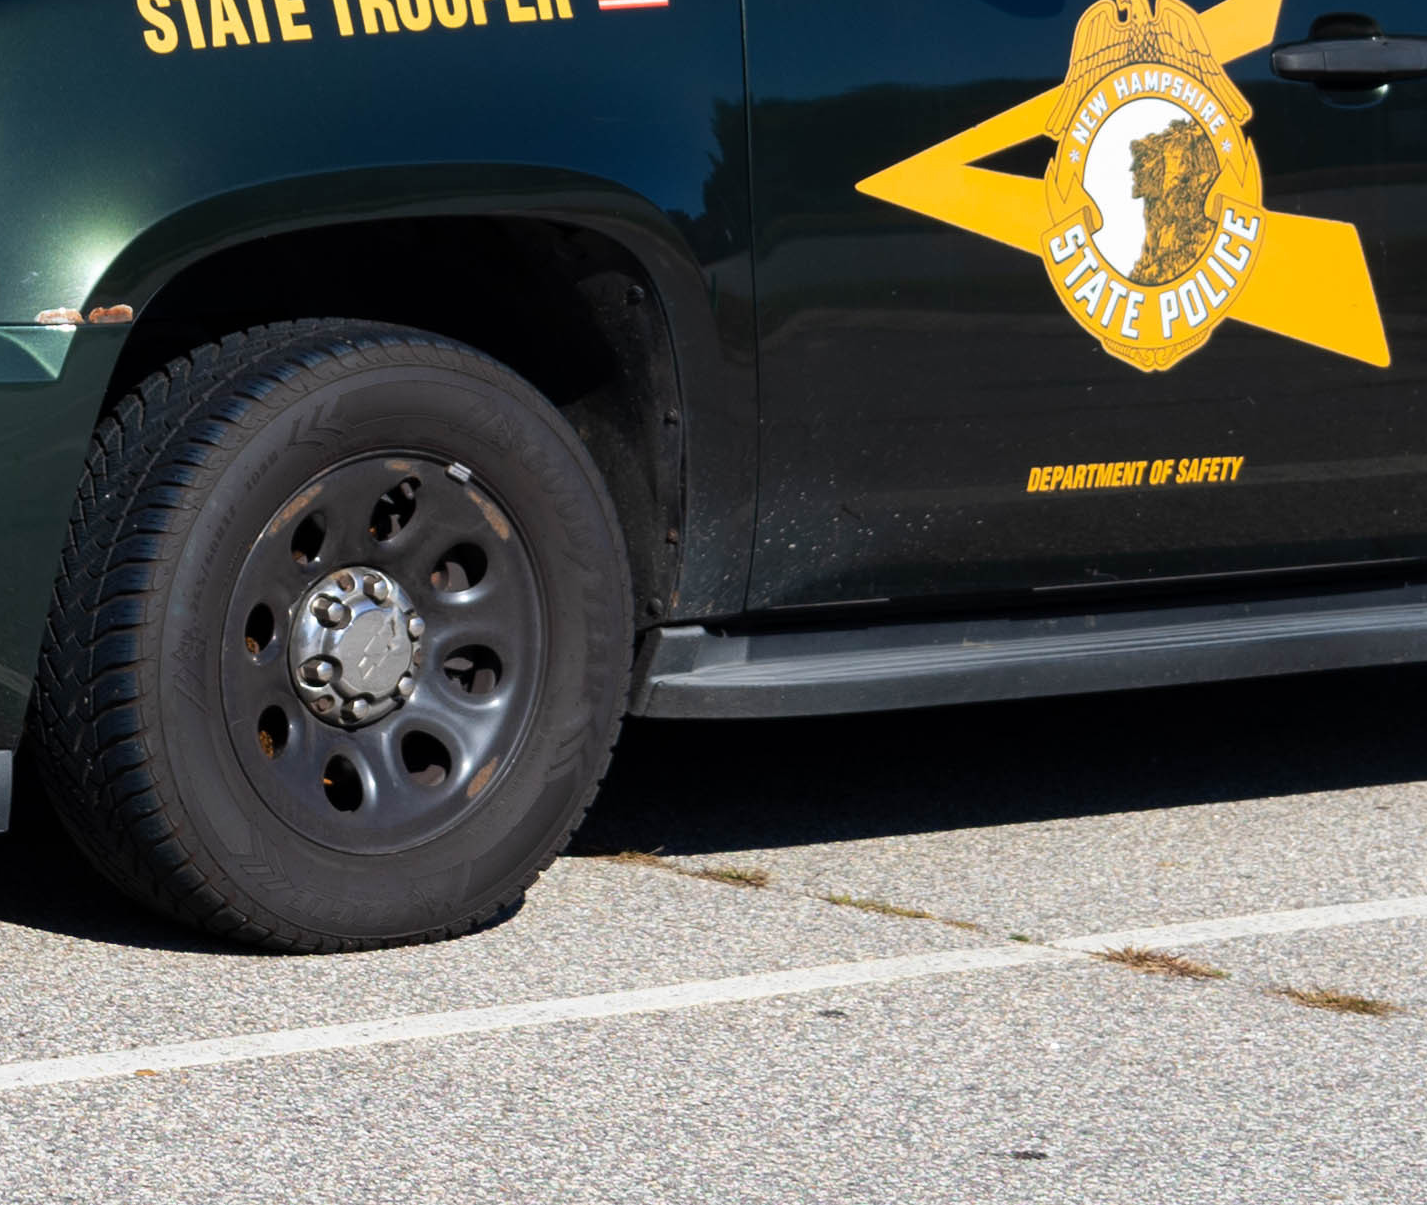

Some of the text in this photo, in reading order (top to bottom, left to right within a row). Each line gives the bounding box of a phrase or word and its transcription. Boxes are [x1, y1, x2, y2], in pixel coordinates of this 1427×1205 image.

[1071, 70, 1226, 146] NEW HAMPSHIRE
[1049, 208, 1262, 340] STATE POLICE
[1026, 456, 1245, 493] DEPARTMENT OF SAFETY
